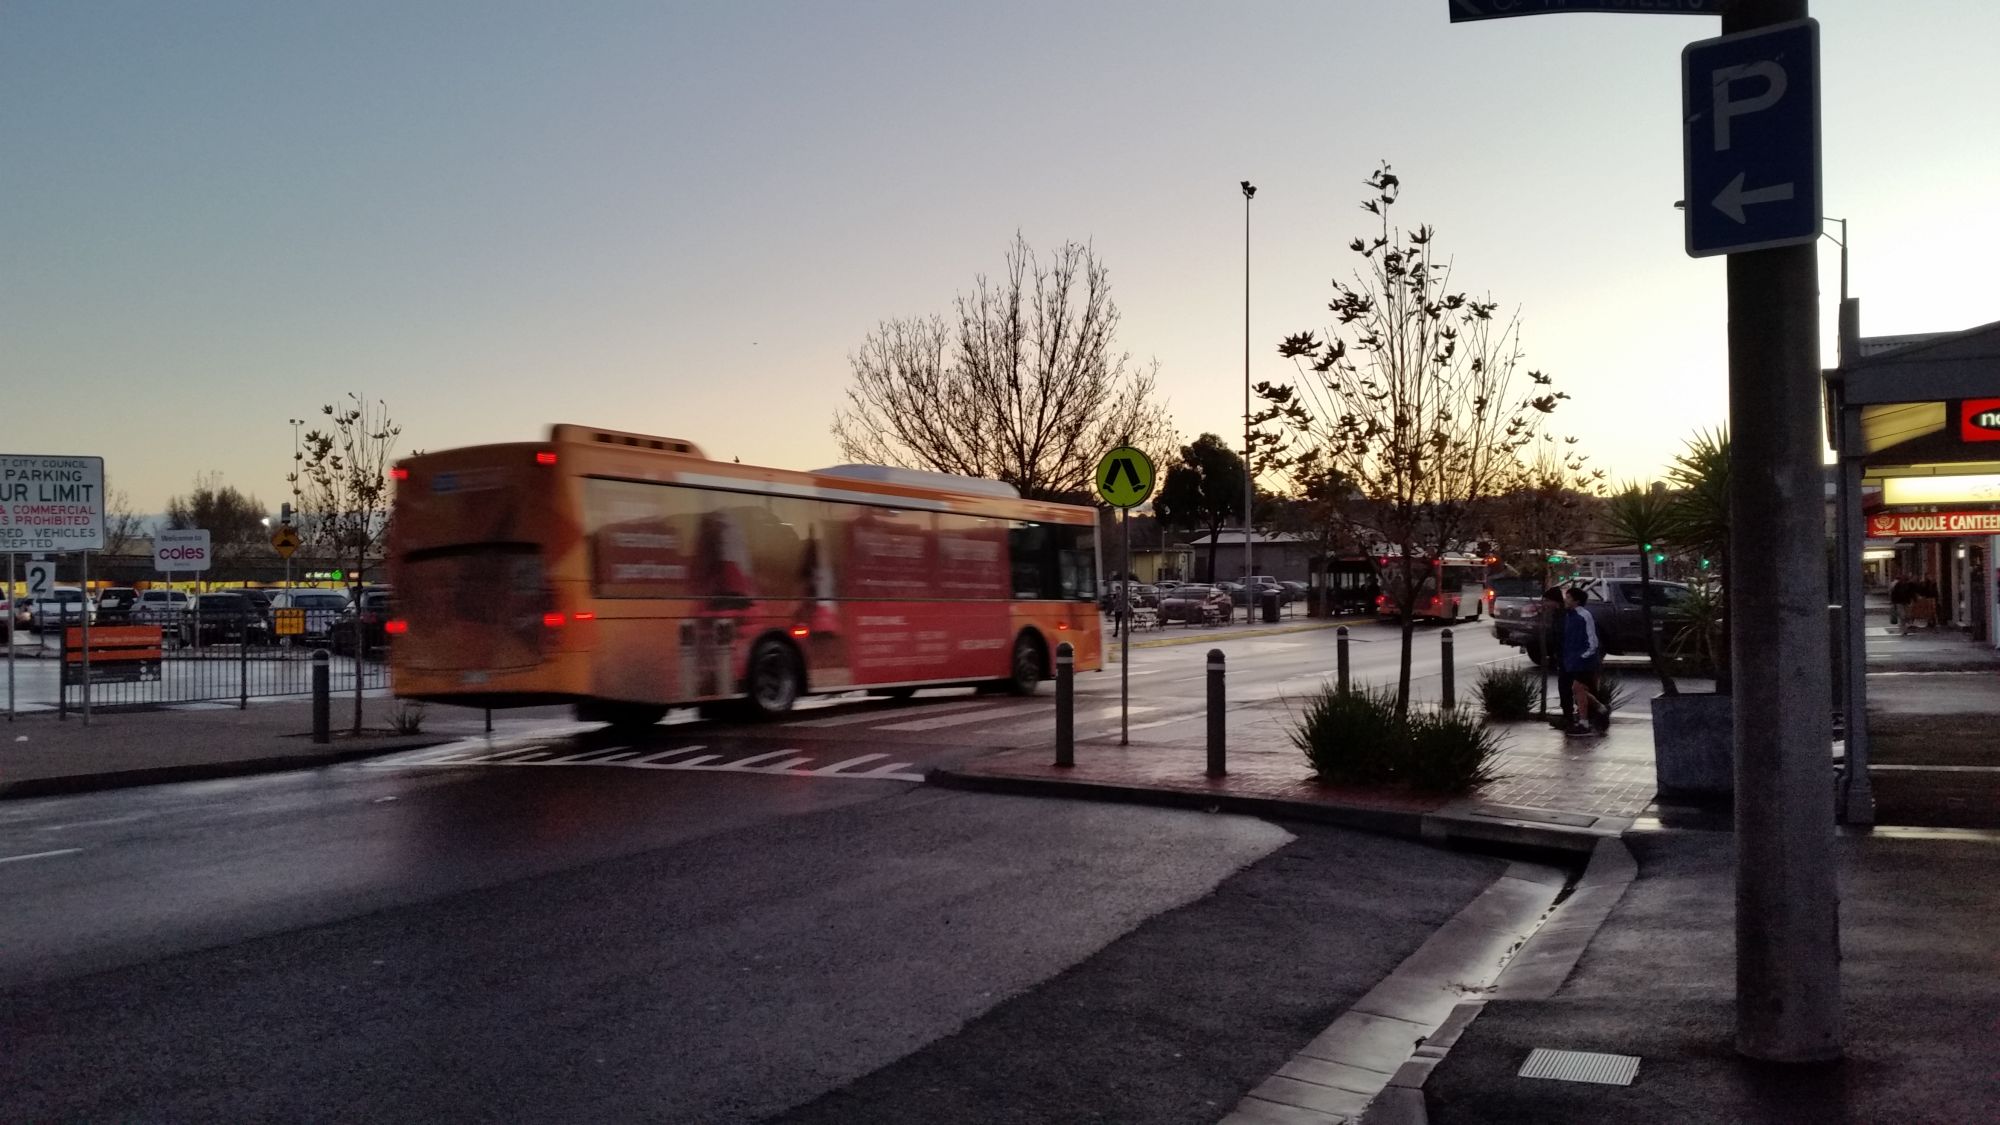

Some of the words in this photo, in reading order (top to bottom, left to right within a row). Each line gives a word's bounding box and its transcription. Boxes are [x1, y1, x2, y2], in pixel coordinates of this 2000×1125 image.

[1712, 57, 1788, 152] P
[12, 459, 38, 468] CITY
[42, 460, 88, 469] COUNCIL
[5, 469, 82, 482] PARKING
[0, 483, 28, 502] UR
[39, 484, 94, 503] LIMIT
[13, 505, 96, 515] COMMERCIAL
[2, 516, 9, 525] S
[15, 515, 90, 526] PROHIBITED
[1900, 515, 1947, 531] NOODLE
[34, 528, 96, 538] VEHICLES
[159, 544, 205, 560] coles
[30, 566, 47, 593] 2
